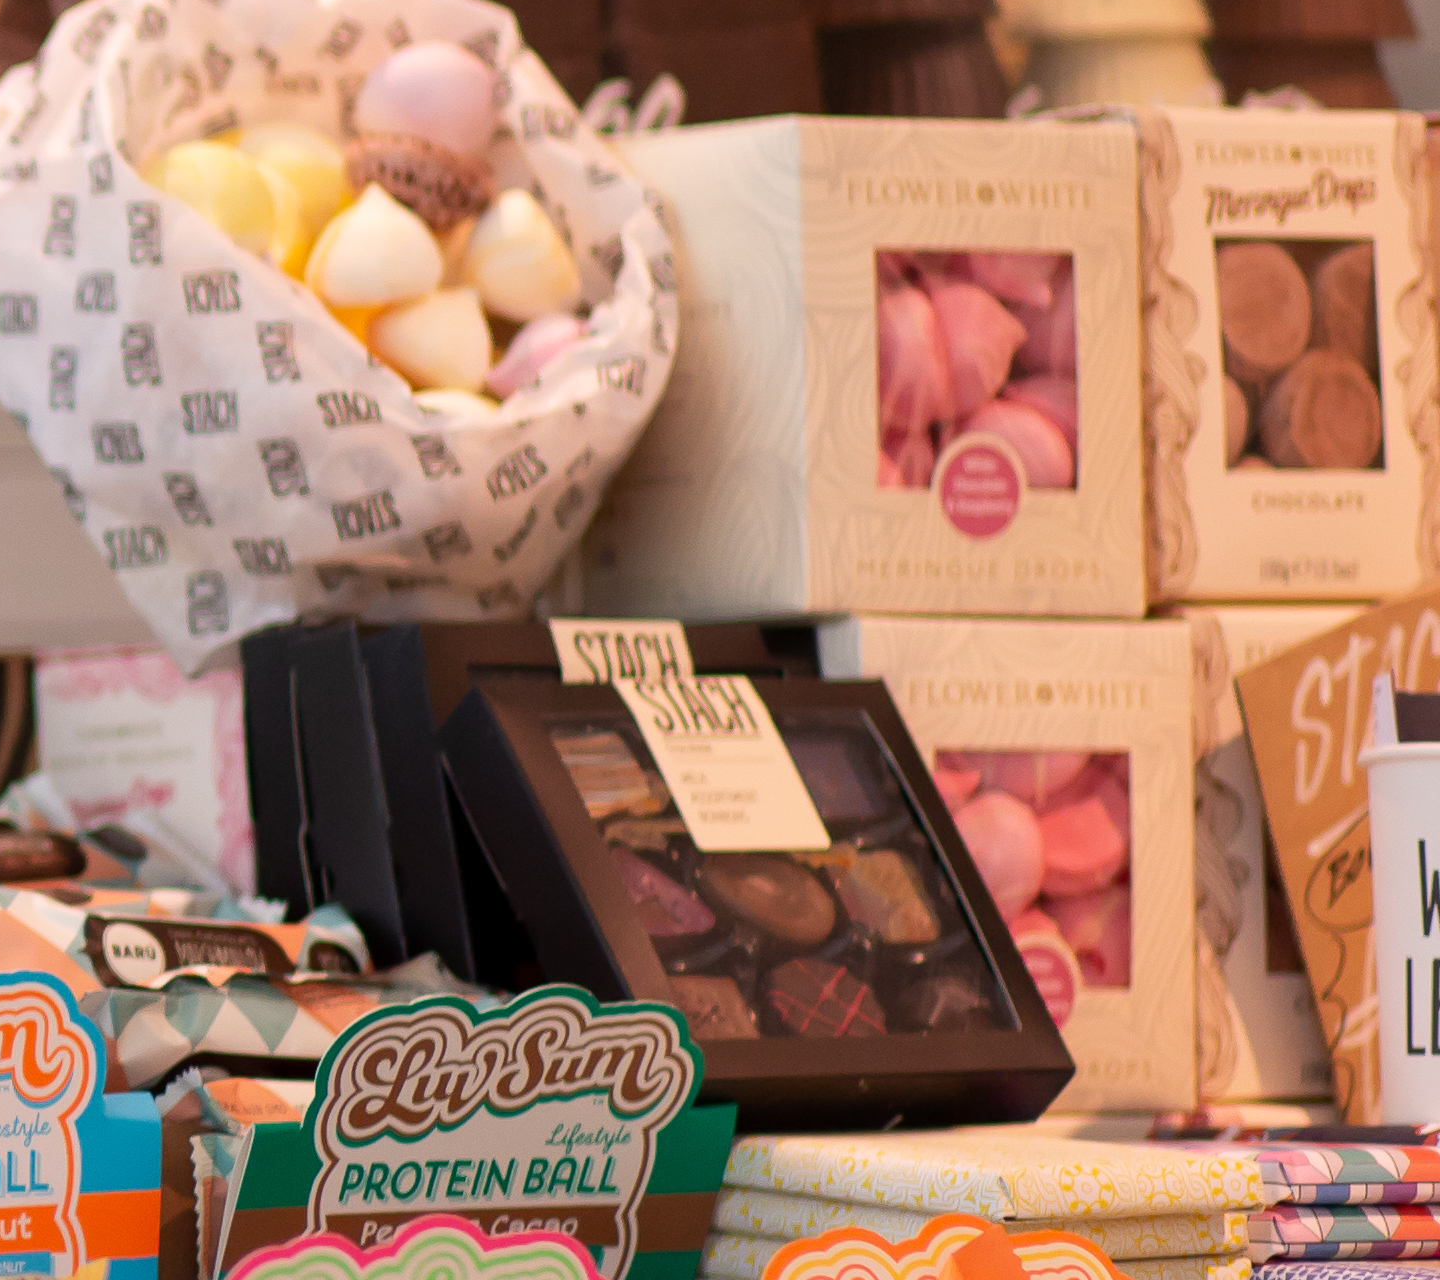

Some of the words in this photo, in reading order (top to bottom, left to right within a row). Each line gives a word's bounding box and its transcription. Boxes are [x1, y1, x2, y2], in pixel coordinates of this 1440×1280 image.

[846, 180, 977, 211] FLOWER
[996, 178, 1095, 212] WHITE
[574, 631, 679, 684] STACH
[635, 677, 759, 733] STACH
[498, 1027, 671, 1114] Sum
[546, 1123, 632, 1149] Lifestyle
[339, 1158, 515, 1203] PROTEIN
[524, 1156, 619, 1195] BALL
